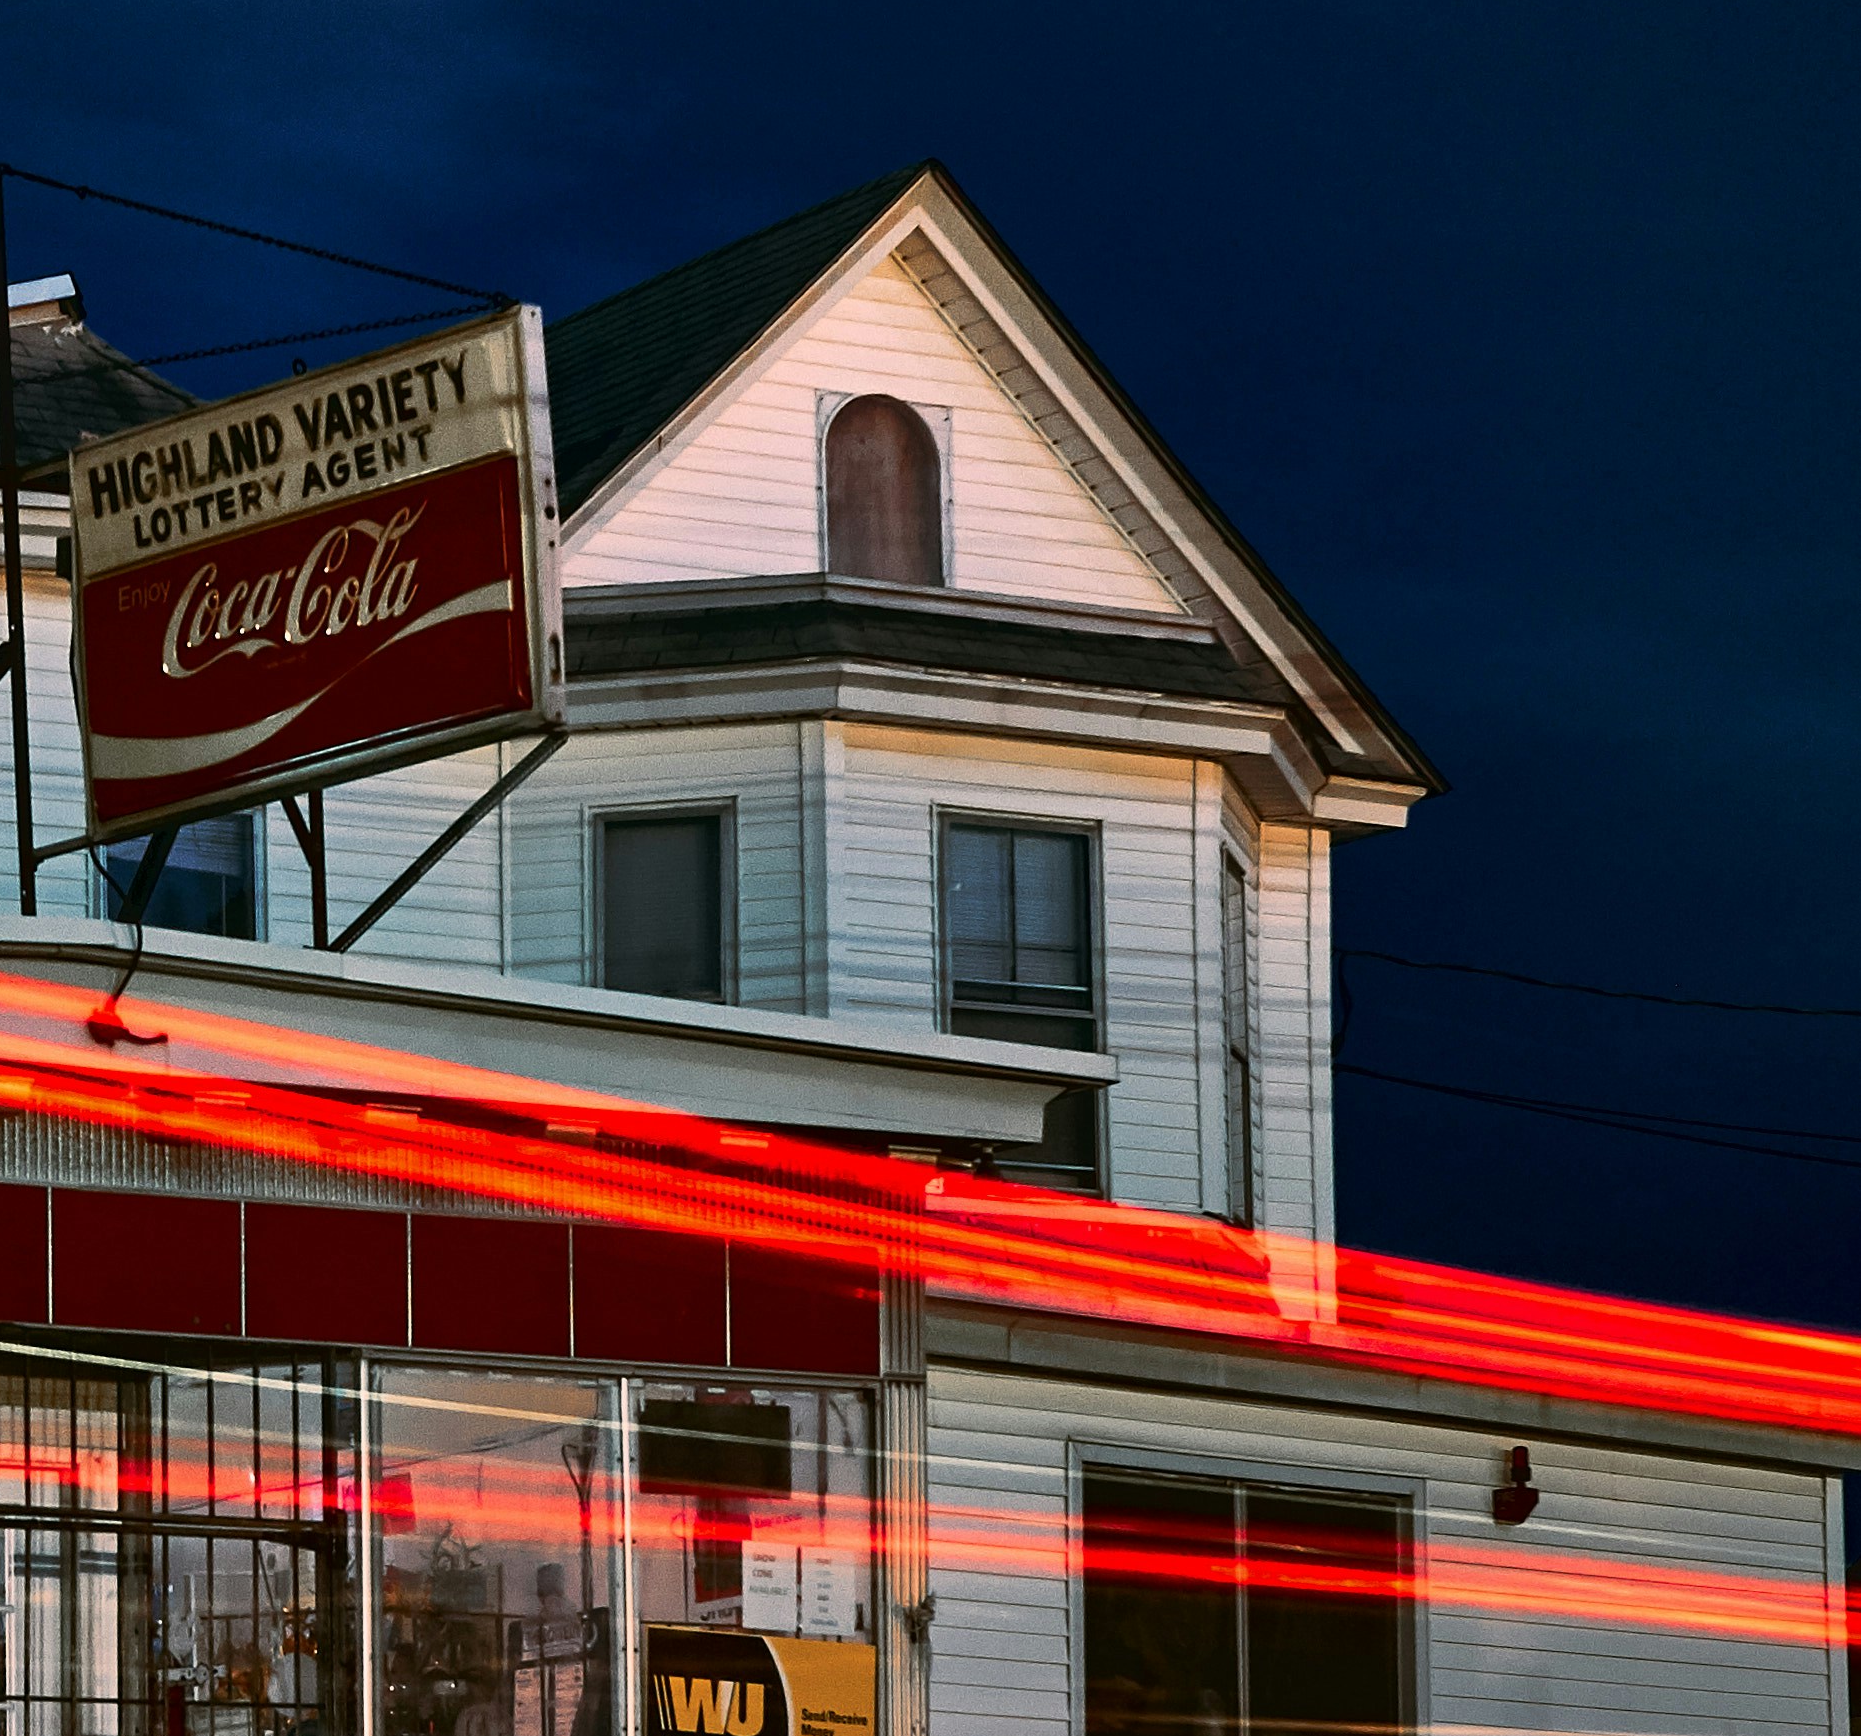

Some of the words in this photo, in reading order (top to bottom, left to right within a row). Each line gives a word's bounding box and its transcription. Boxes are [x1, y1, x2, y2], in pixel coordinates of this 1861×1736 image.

[89, 414, 284, 520] HIGHLAND
[293, 349, 468, 454] VARIETY
[133, 470, 285, 547] LOTTERY
[302, 423, 432, 499] AGENT
[118, 578, 171, 612] Enjoy
[162, 499, 428, 678] Coca-Cola
